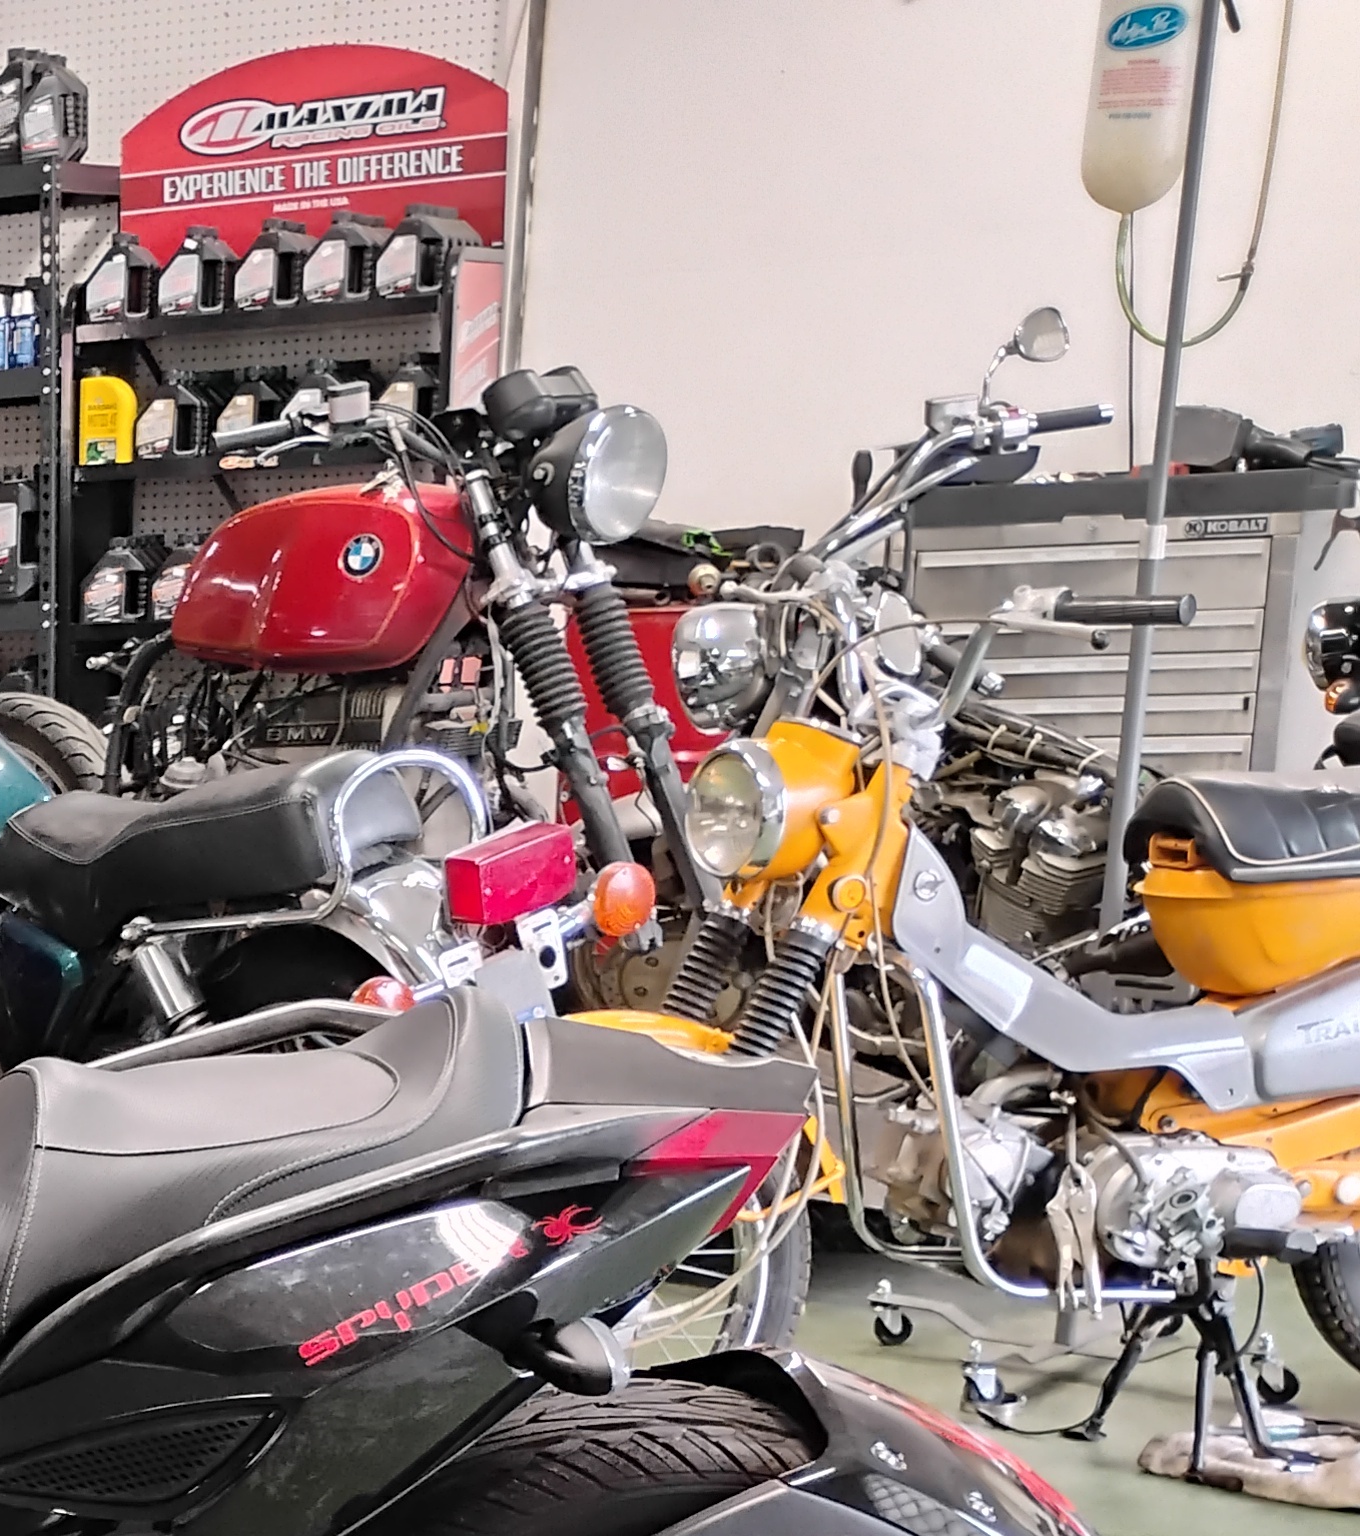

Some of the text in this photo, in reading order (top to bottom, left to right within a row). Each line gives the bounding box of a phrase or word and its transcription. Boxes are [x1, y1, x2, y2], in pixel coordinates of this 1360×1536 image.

[250, 86, 446, 134] MAXIMA
[163, 145, 464, 203] EXPERIENCE THE DIFFERENCE
[330, 196, 349, 207] USA
[1206, 519, 1266, 533] KOBALT
[266, 727, 327, 741] BMW
